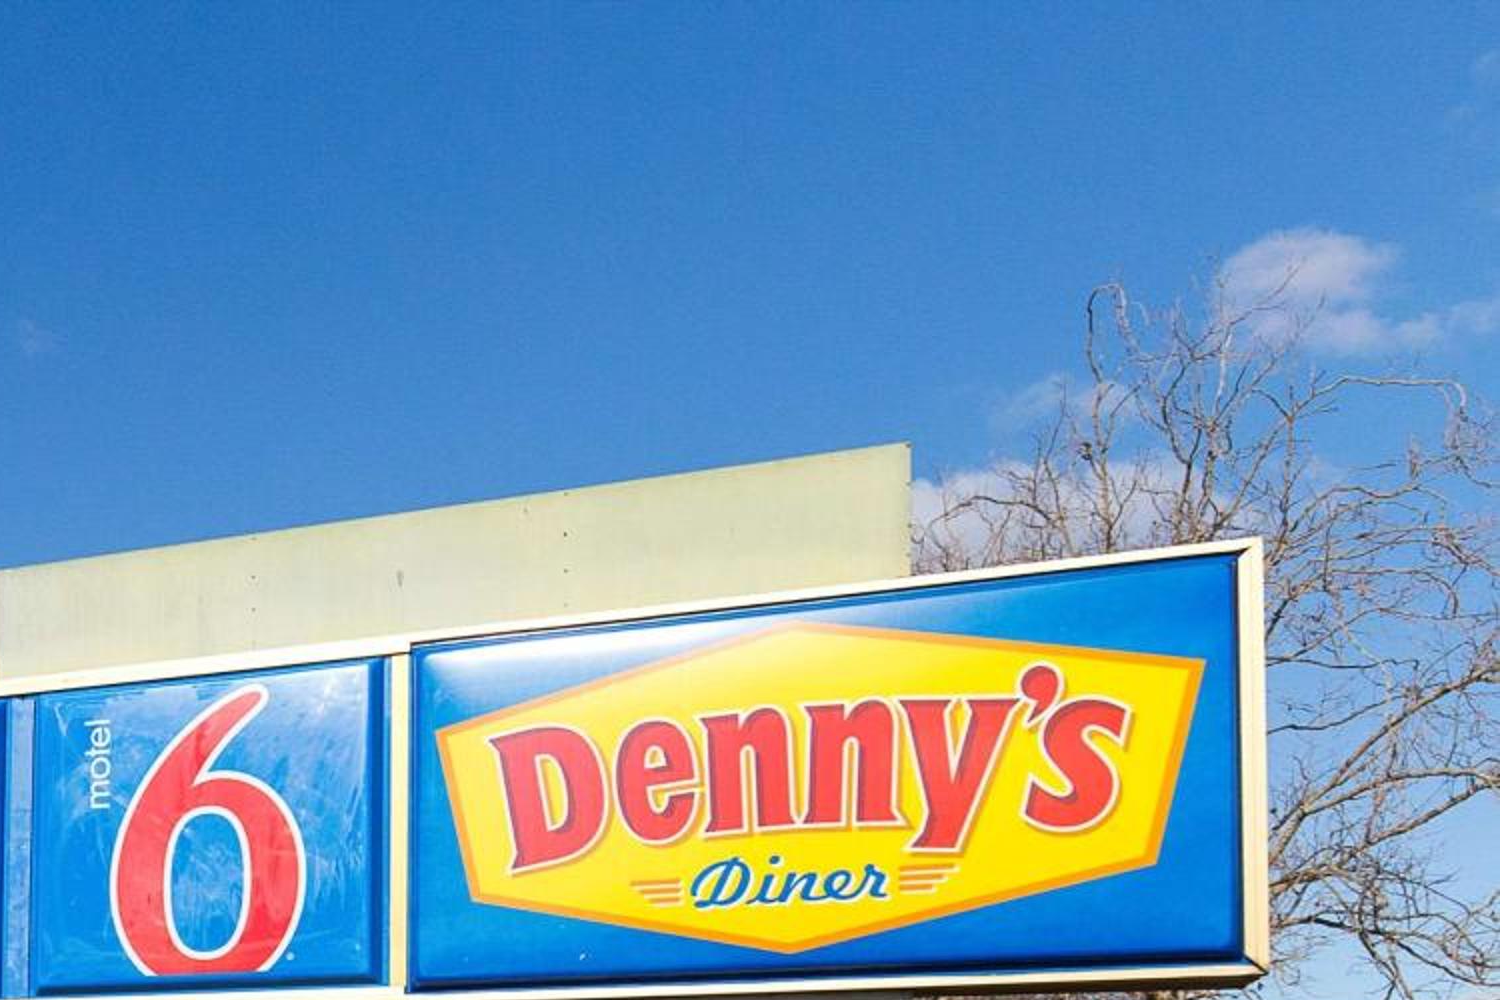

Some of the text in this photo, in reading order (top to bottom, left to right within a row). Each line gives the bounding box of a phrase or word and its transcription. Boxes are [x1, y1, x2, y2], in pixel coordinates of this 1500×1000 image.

[83, 680, 307, 976] motel 6
[489, 663, 1136, 874] Denny's
[692, 855, 891, 908] Diner
